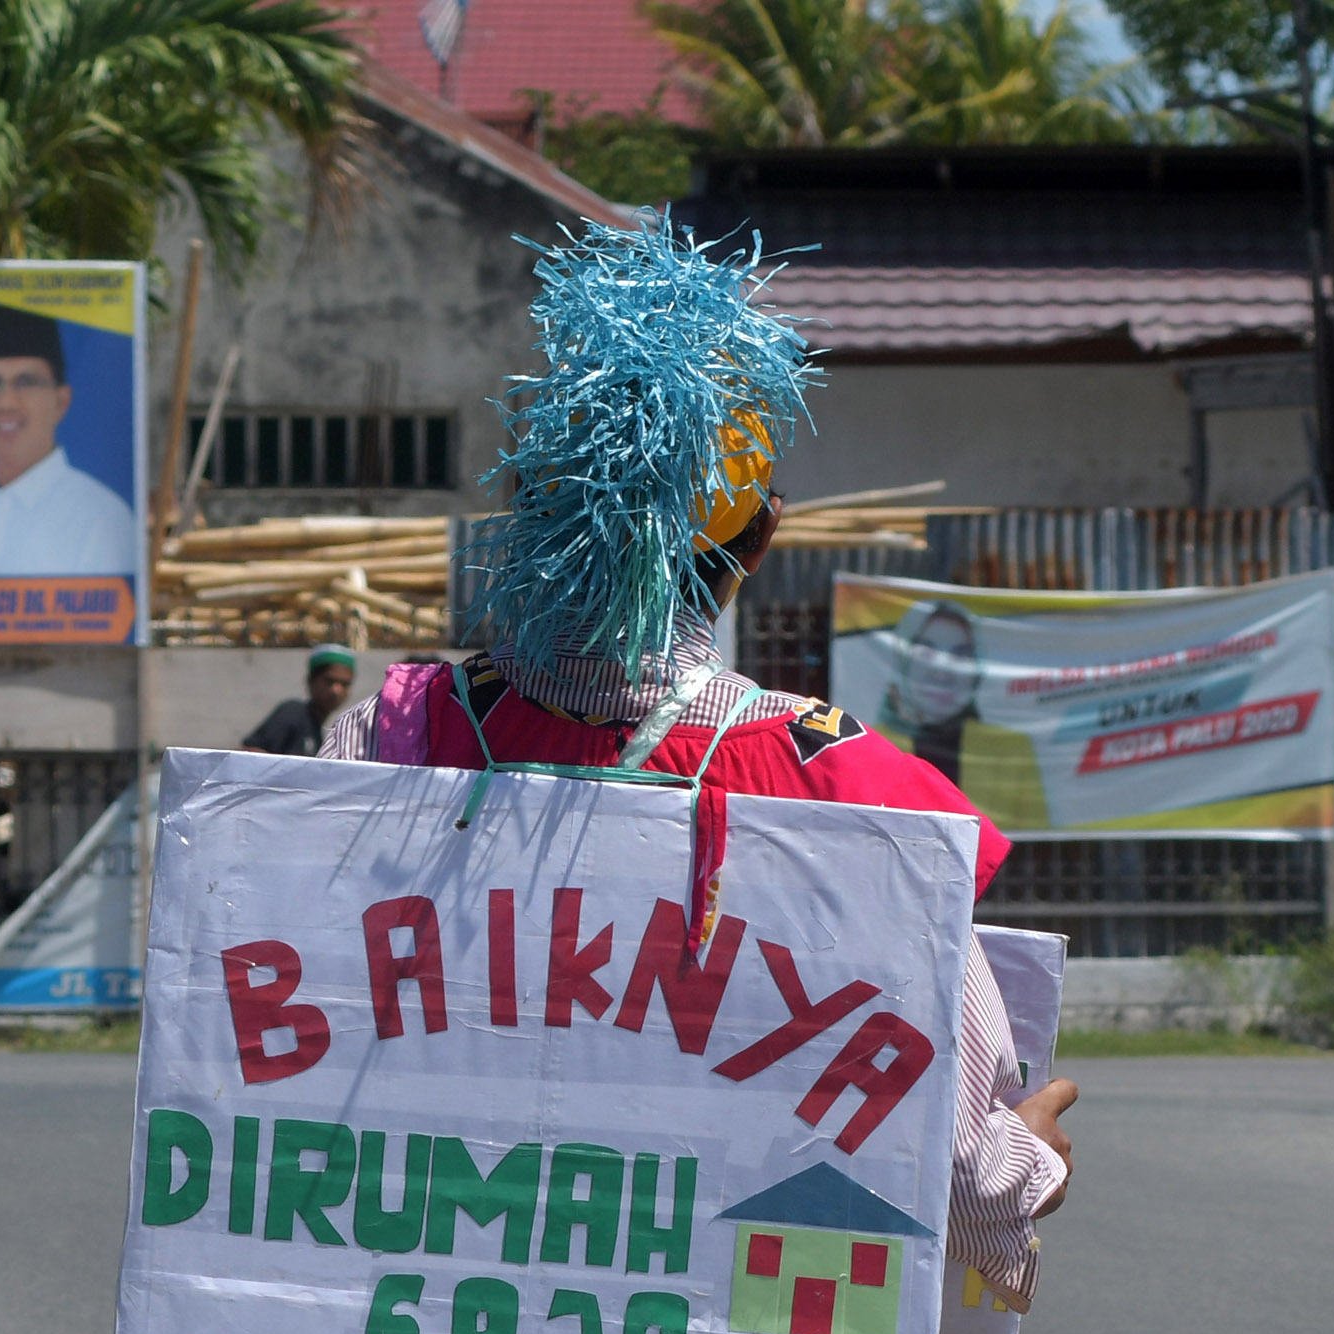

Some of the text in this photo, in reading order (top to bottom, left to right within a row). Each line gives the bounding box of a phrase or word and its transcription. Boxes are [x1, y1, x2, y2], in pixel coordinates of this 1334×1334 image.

[1098, 689, 1202, 726] UNTUK
[1100, 728, 1168, 764] KOTA
[1173, 713, 1236, 750] PALU
